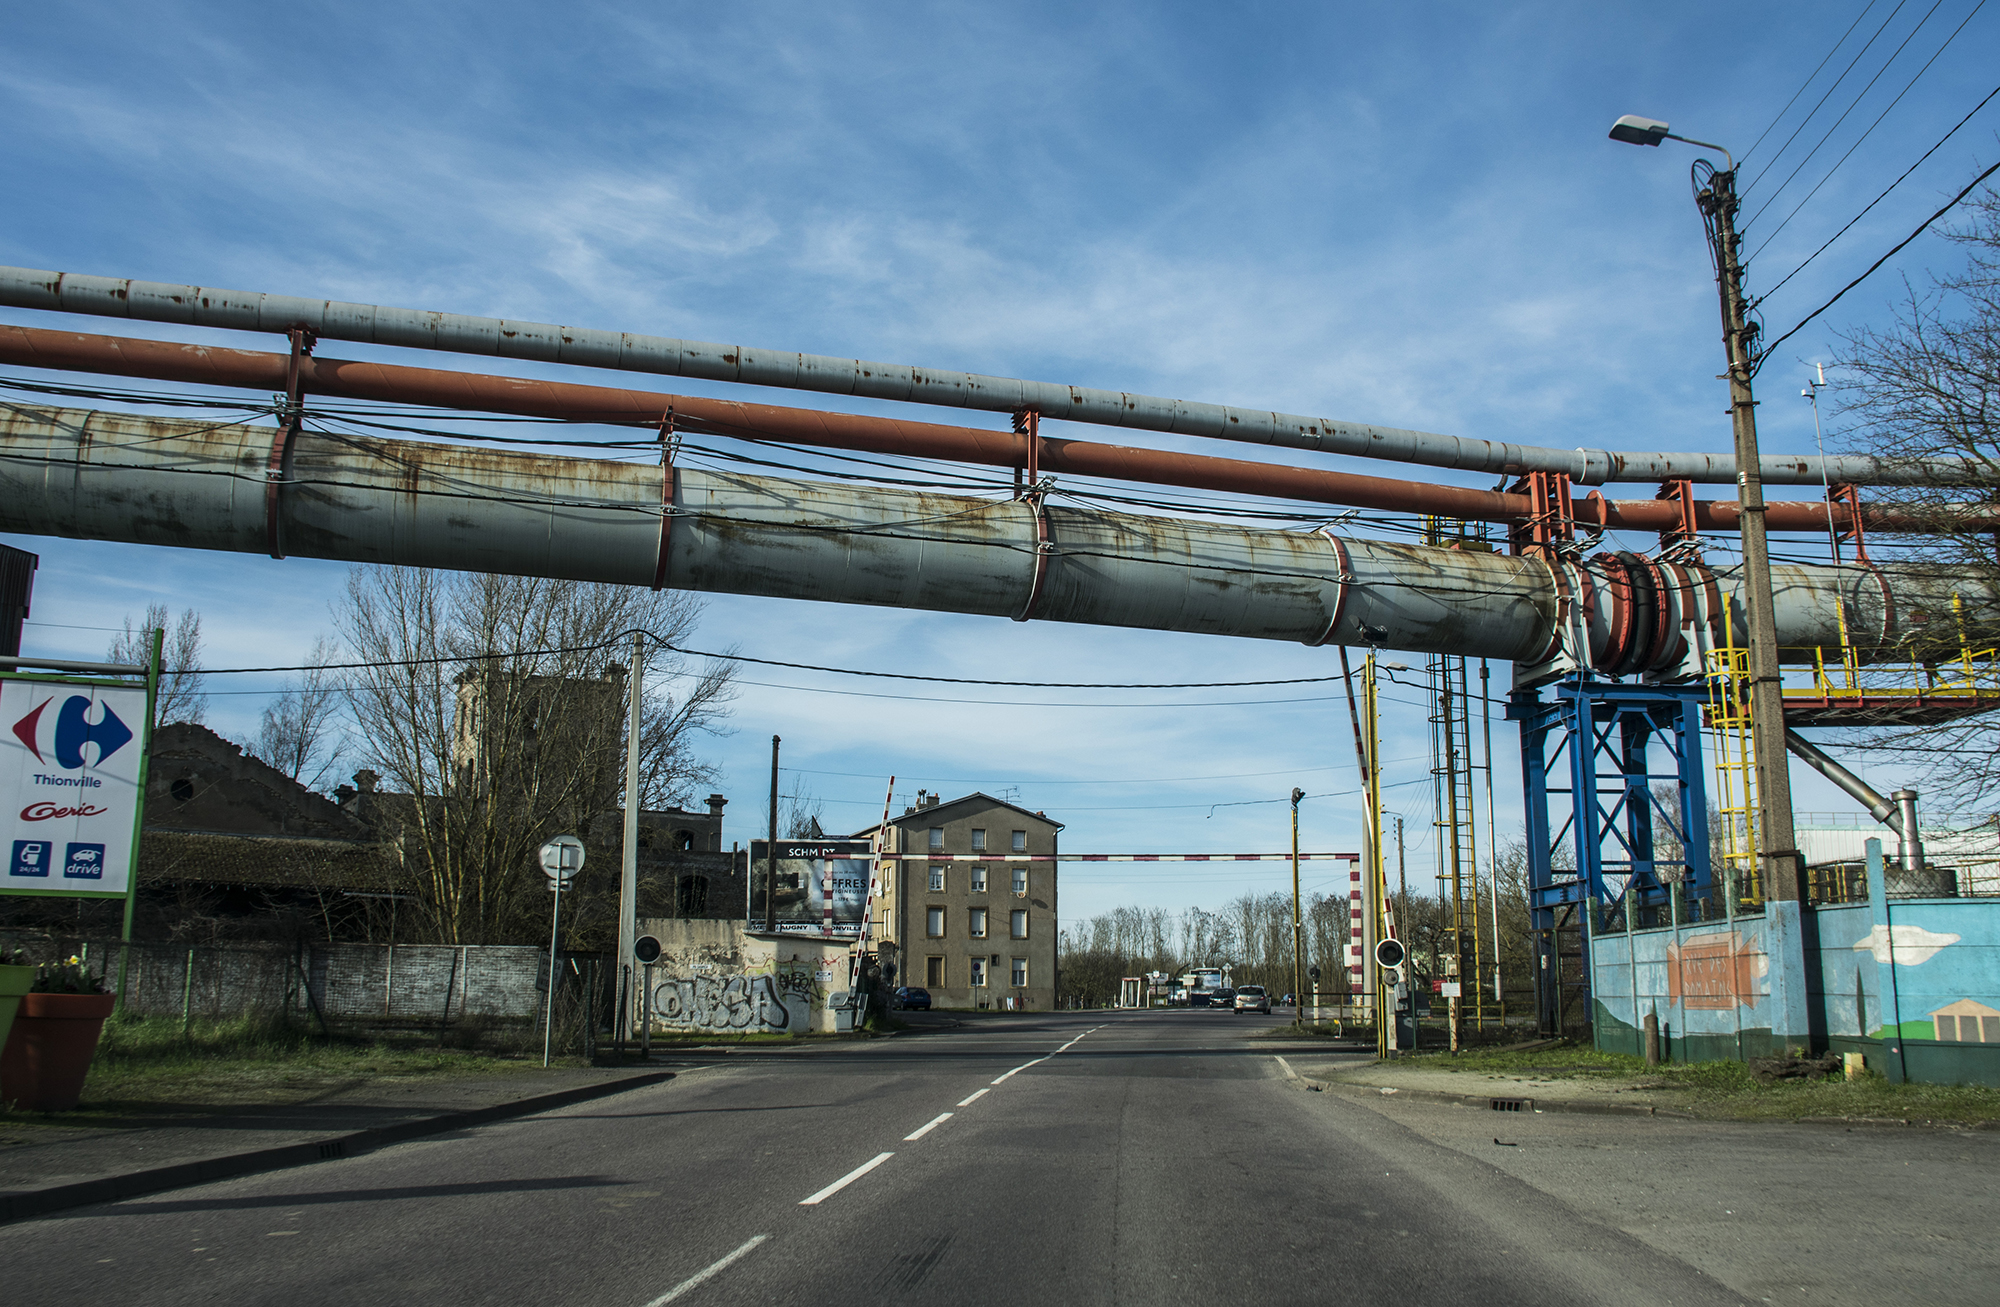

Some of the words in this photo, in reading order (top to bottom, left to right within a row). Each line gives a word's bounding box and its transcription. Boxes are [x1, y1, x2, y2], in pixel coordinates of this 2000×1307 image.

[33, 774, 102, 788] Thionville
[20, 802, 108, 822] Geric
[66, 863, 101, 874] drive
